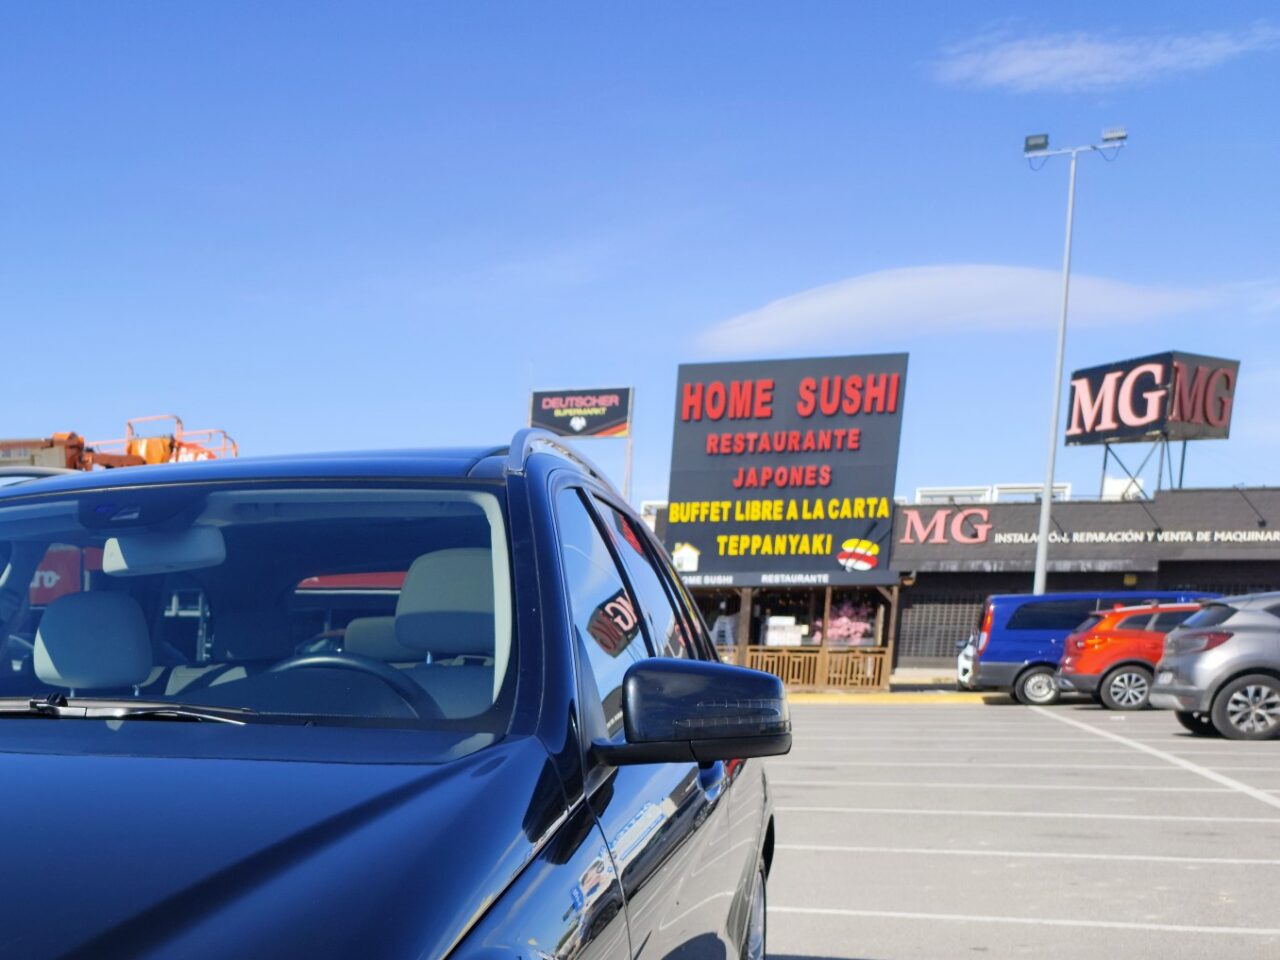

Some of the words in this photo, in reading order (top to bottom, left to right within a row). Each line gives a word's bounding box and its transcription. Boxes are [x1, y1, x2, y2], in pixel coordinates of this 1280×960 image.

[542, 394, 620, 410] DEUTSCHER
[681, 379, 775, 421] HOME
[796, 372, 900, 417] SUSHI
[1066, 363, 1168, 436] MG
[1169, 360, 1235, 428] MG
[554, 407, 607, 417] SUPERMARKT
[706, 428, 861, 455] RESTAURANTE
[732, 465, 832, 489] JAPONES
[669, 502, 731, 523] BUFFET
[735, 500, 784, 522] LIBRE
[785, 500, 799, 521] A
[802, 500, 825, 520] LA
[828, 497, 890, 520] CARTA
[899, 508, 993, 544] MG
[1073, 529, 1145, 543] REPARACIÓN
[1147, 531, 1155, 542] Y
[1157, 531, 1193, 542] VENTA
[1196, 531, 1211, 542] DE
[717, 534, 833, 556] TEPPANYAKI
[761, 574, 829, 584] RESTAURANTE
